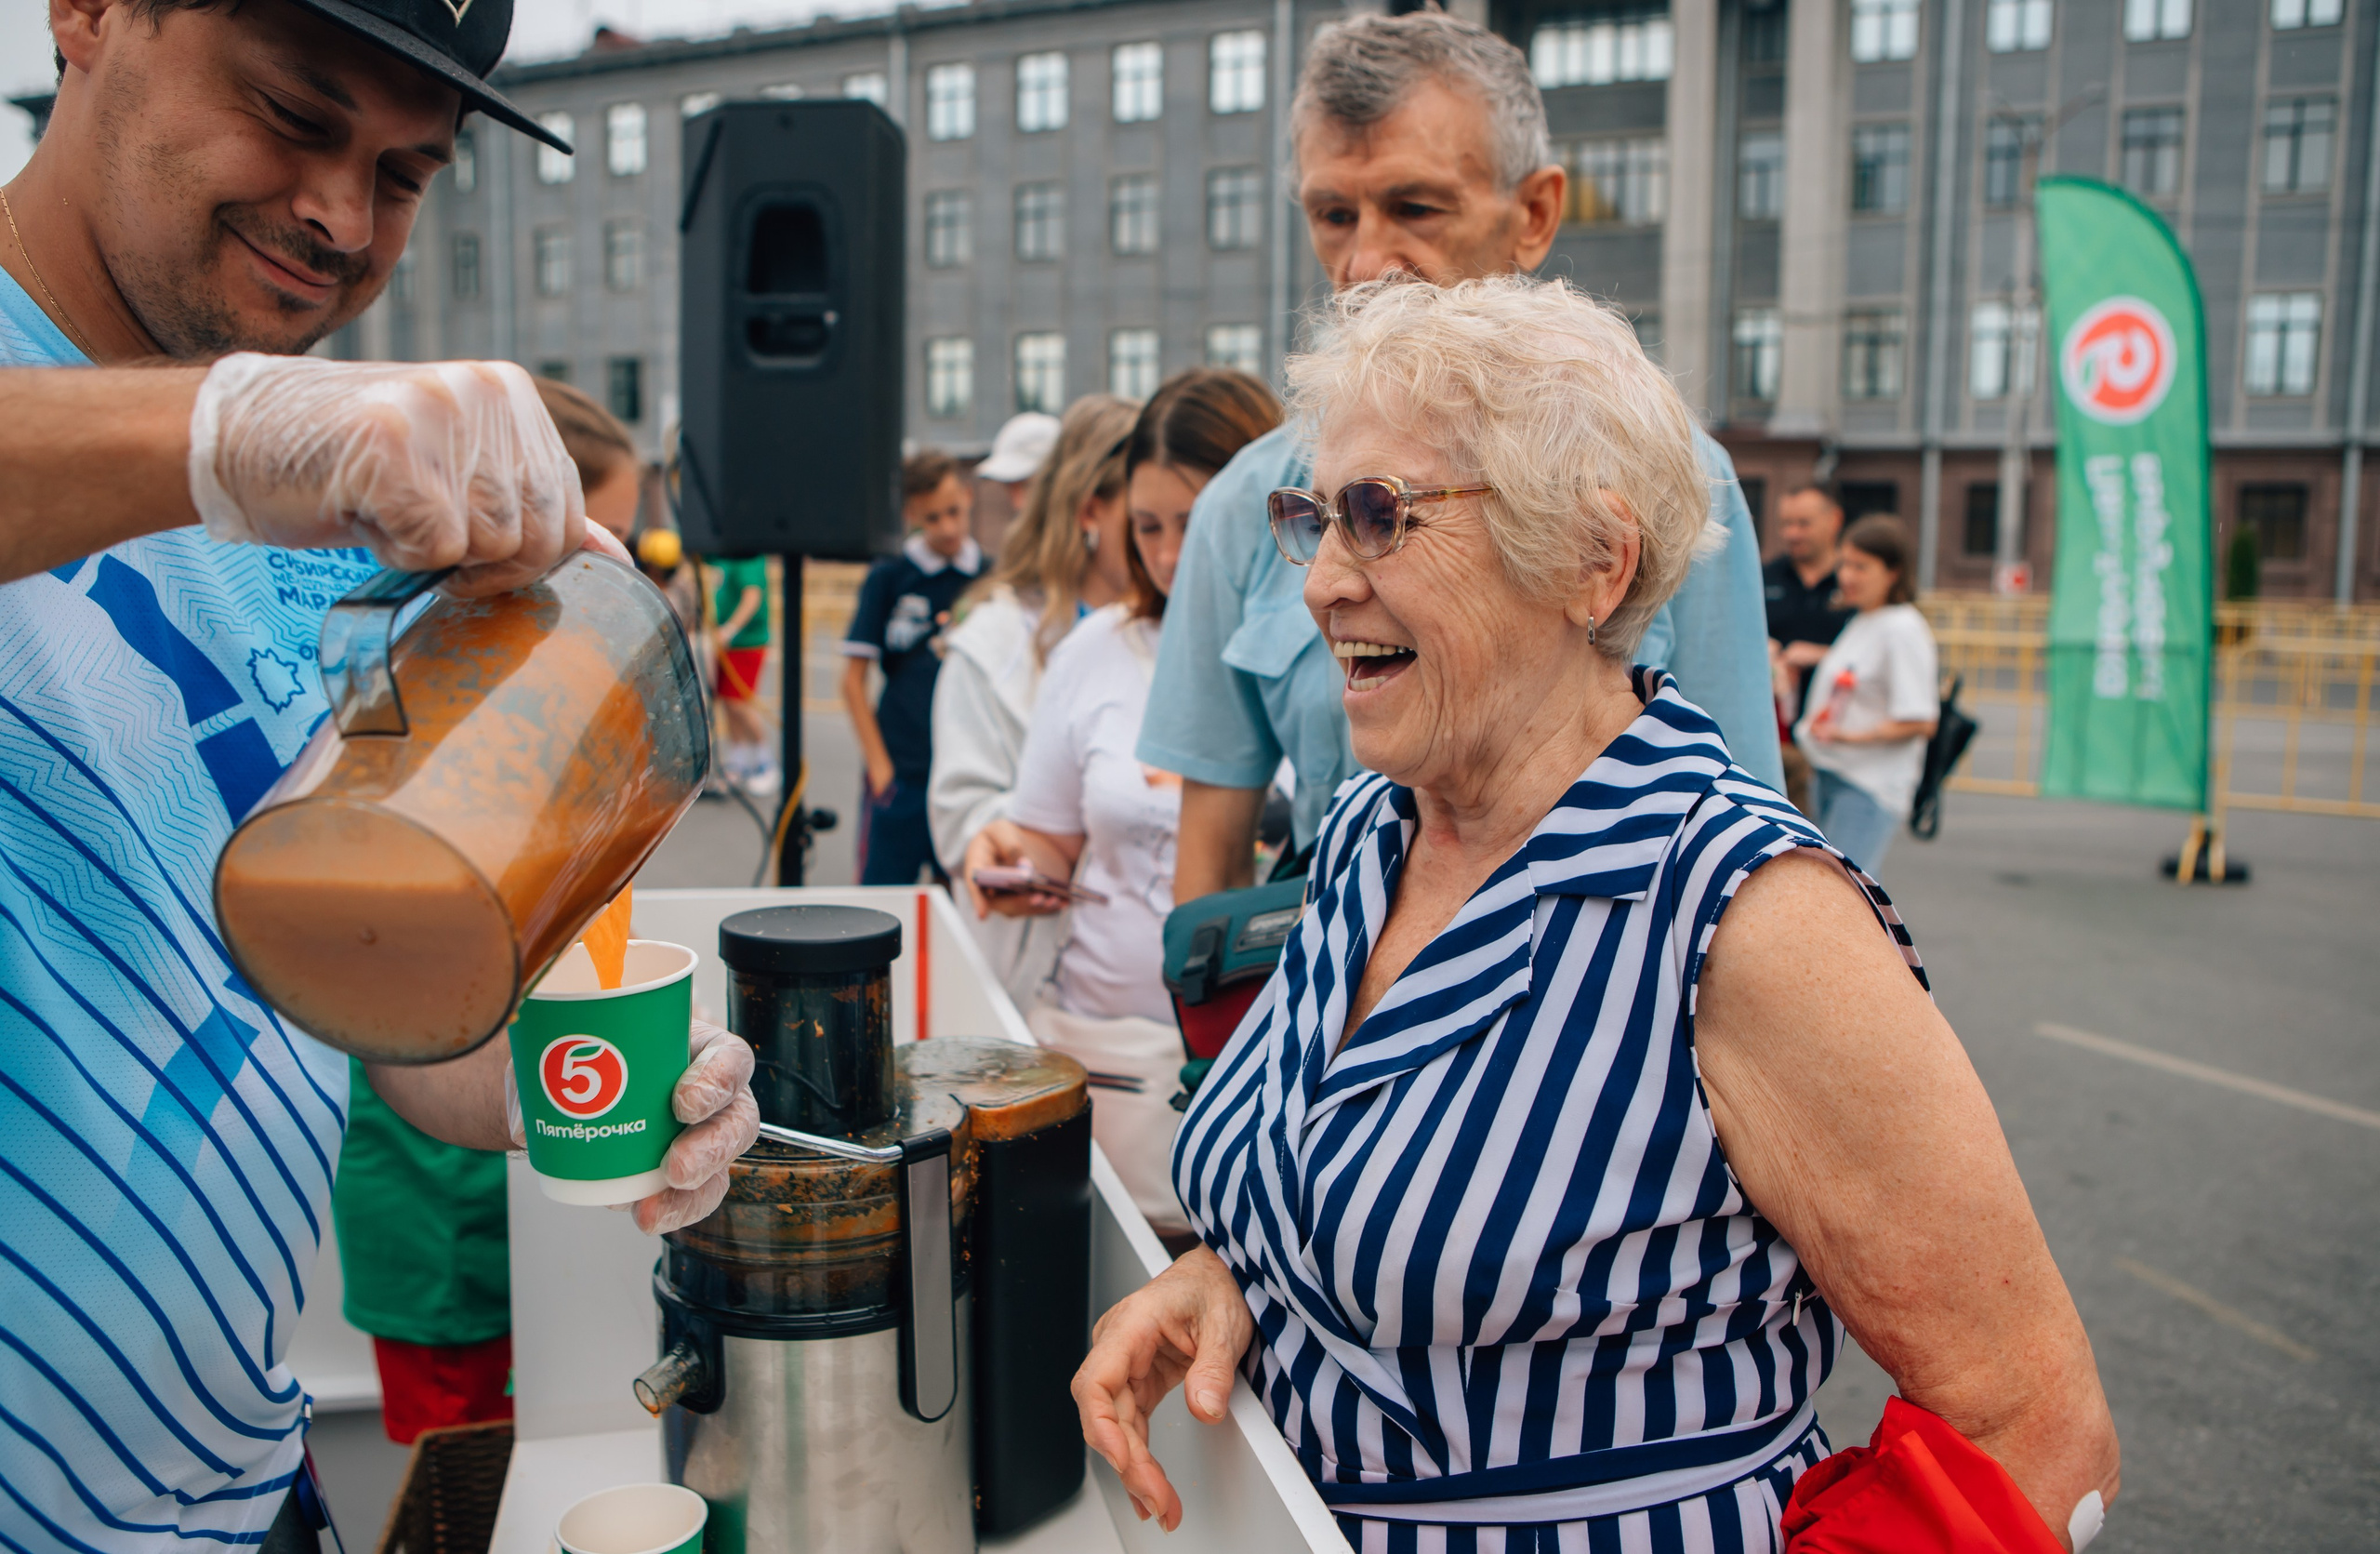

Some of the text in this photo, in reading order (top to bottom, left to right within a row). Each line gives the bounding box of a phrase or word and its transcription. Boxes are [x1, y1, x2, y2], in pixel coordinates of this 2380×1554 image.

[298, 644, 320, 661] О
[561, 1043, 606, 1104] 5
[536, 1119, 646, 1142] Пятёрочка
